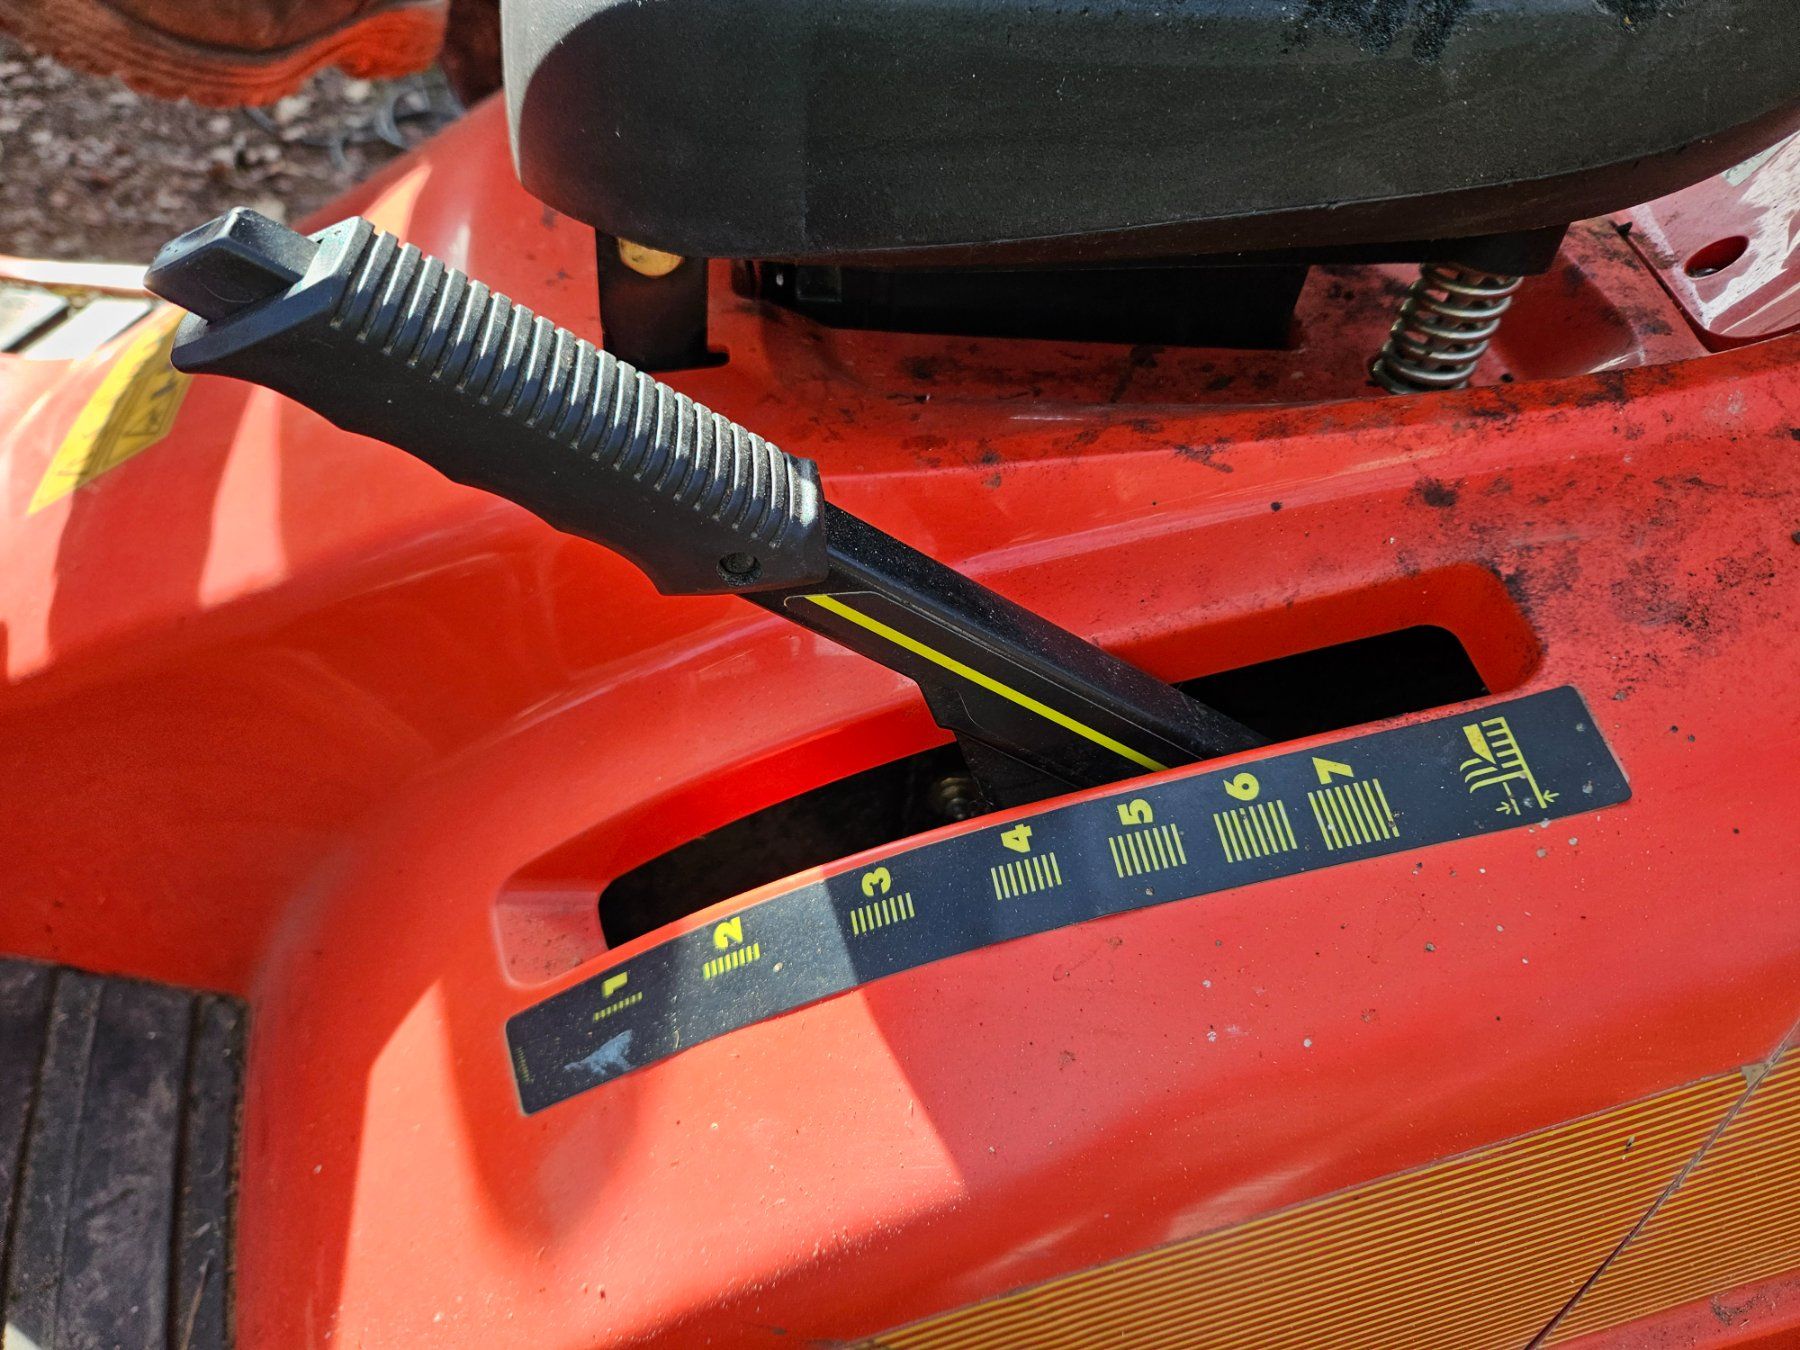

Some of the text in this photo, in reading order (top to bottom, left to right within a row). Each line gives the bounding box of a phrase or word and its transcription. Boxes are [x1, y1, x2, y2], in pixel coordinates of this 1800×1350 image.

[1313, 757, 1354, 784] 7
[1224, 773, 1259, 800] 6
[1117, 799, 1152, 825] 5
[1001, 824, 1031, 852] 4
[861, 867, 891, 896] 3
[713, 916, 744, 949] 2
[602, 972, 628, 998] 1
